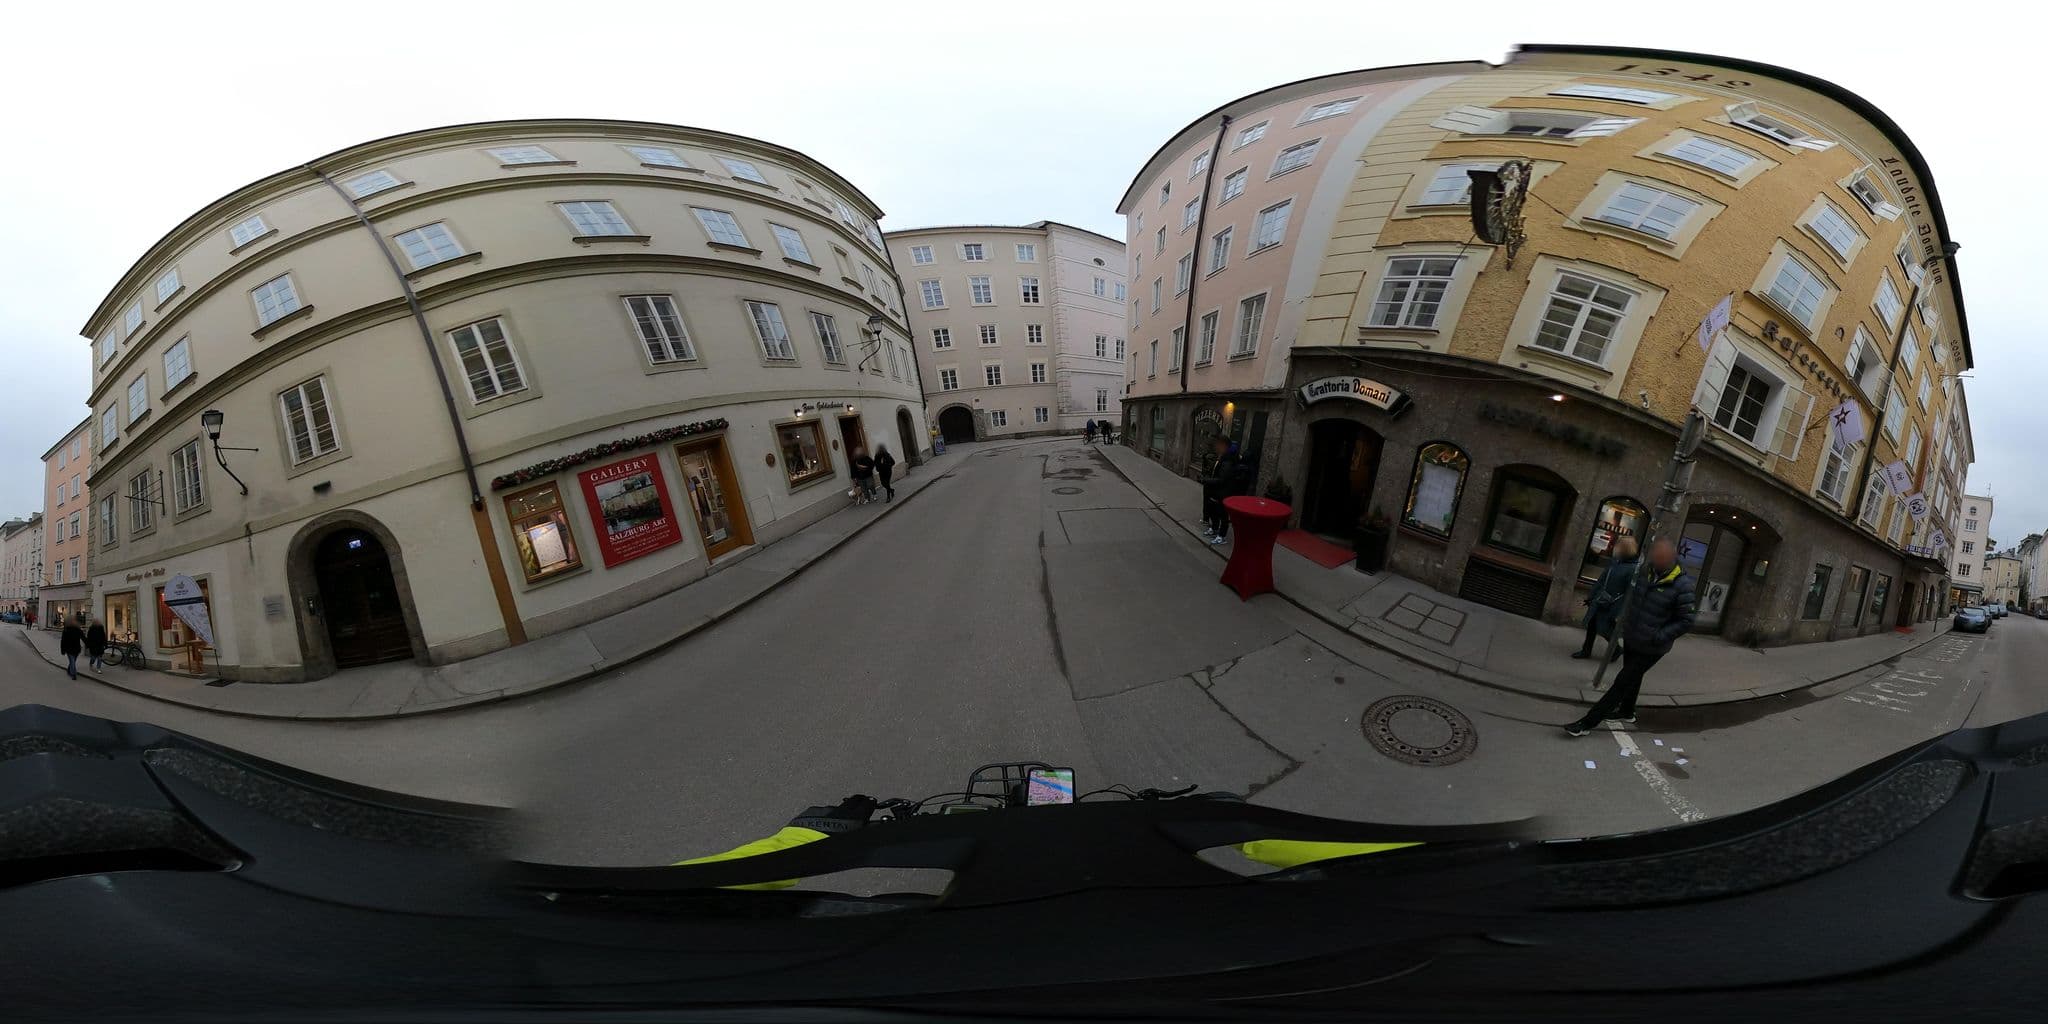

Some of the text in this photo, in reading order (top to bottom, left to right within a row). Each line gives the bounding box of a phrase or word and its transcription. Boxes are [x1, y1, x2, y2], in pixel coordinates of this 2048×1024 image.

[1878, 156, 1921, 217] Laudate
[1307, 378, 1392, 404] Trattoria Domani
[590, 458, 649, 482] GALLERY
[609, 523, 650, 543] SALZBURG
[652, 517, 667, 531] ART
